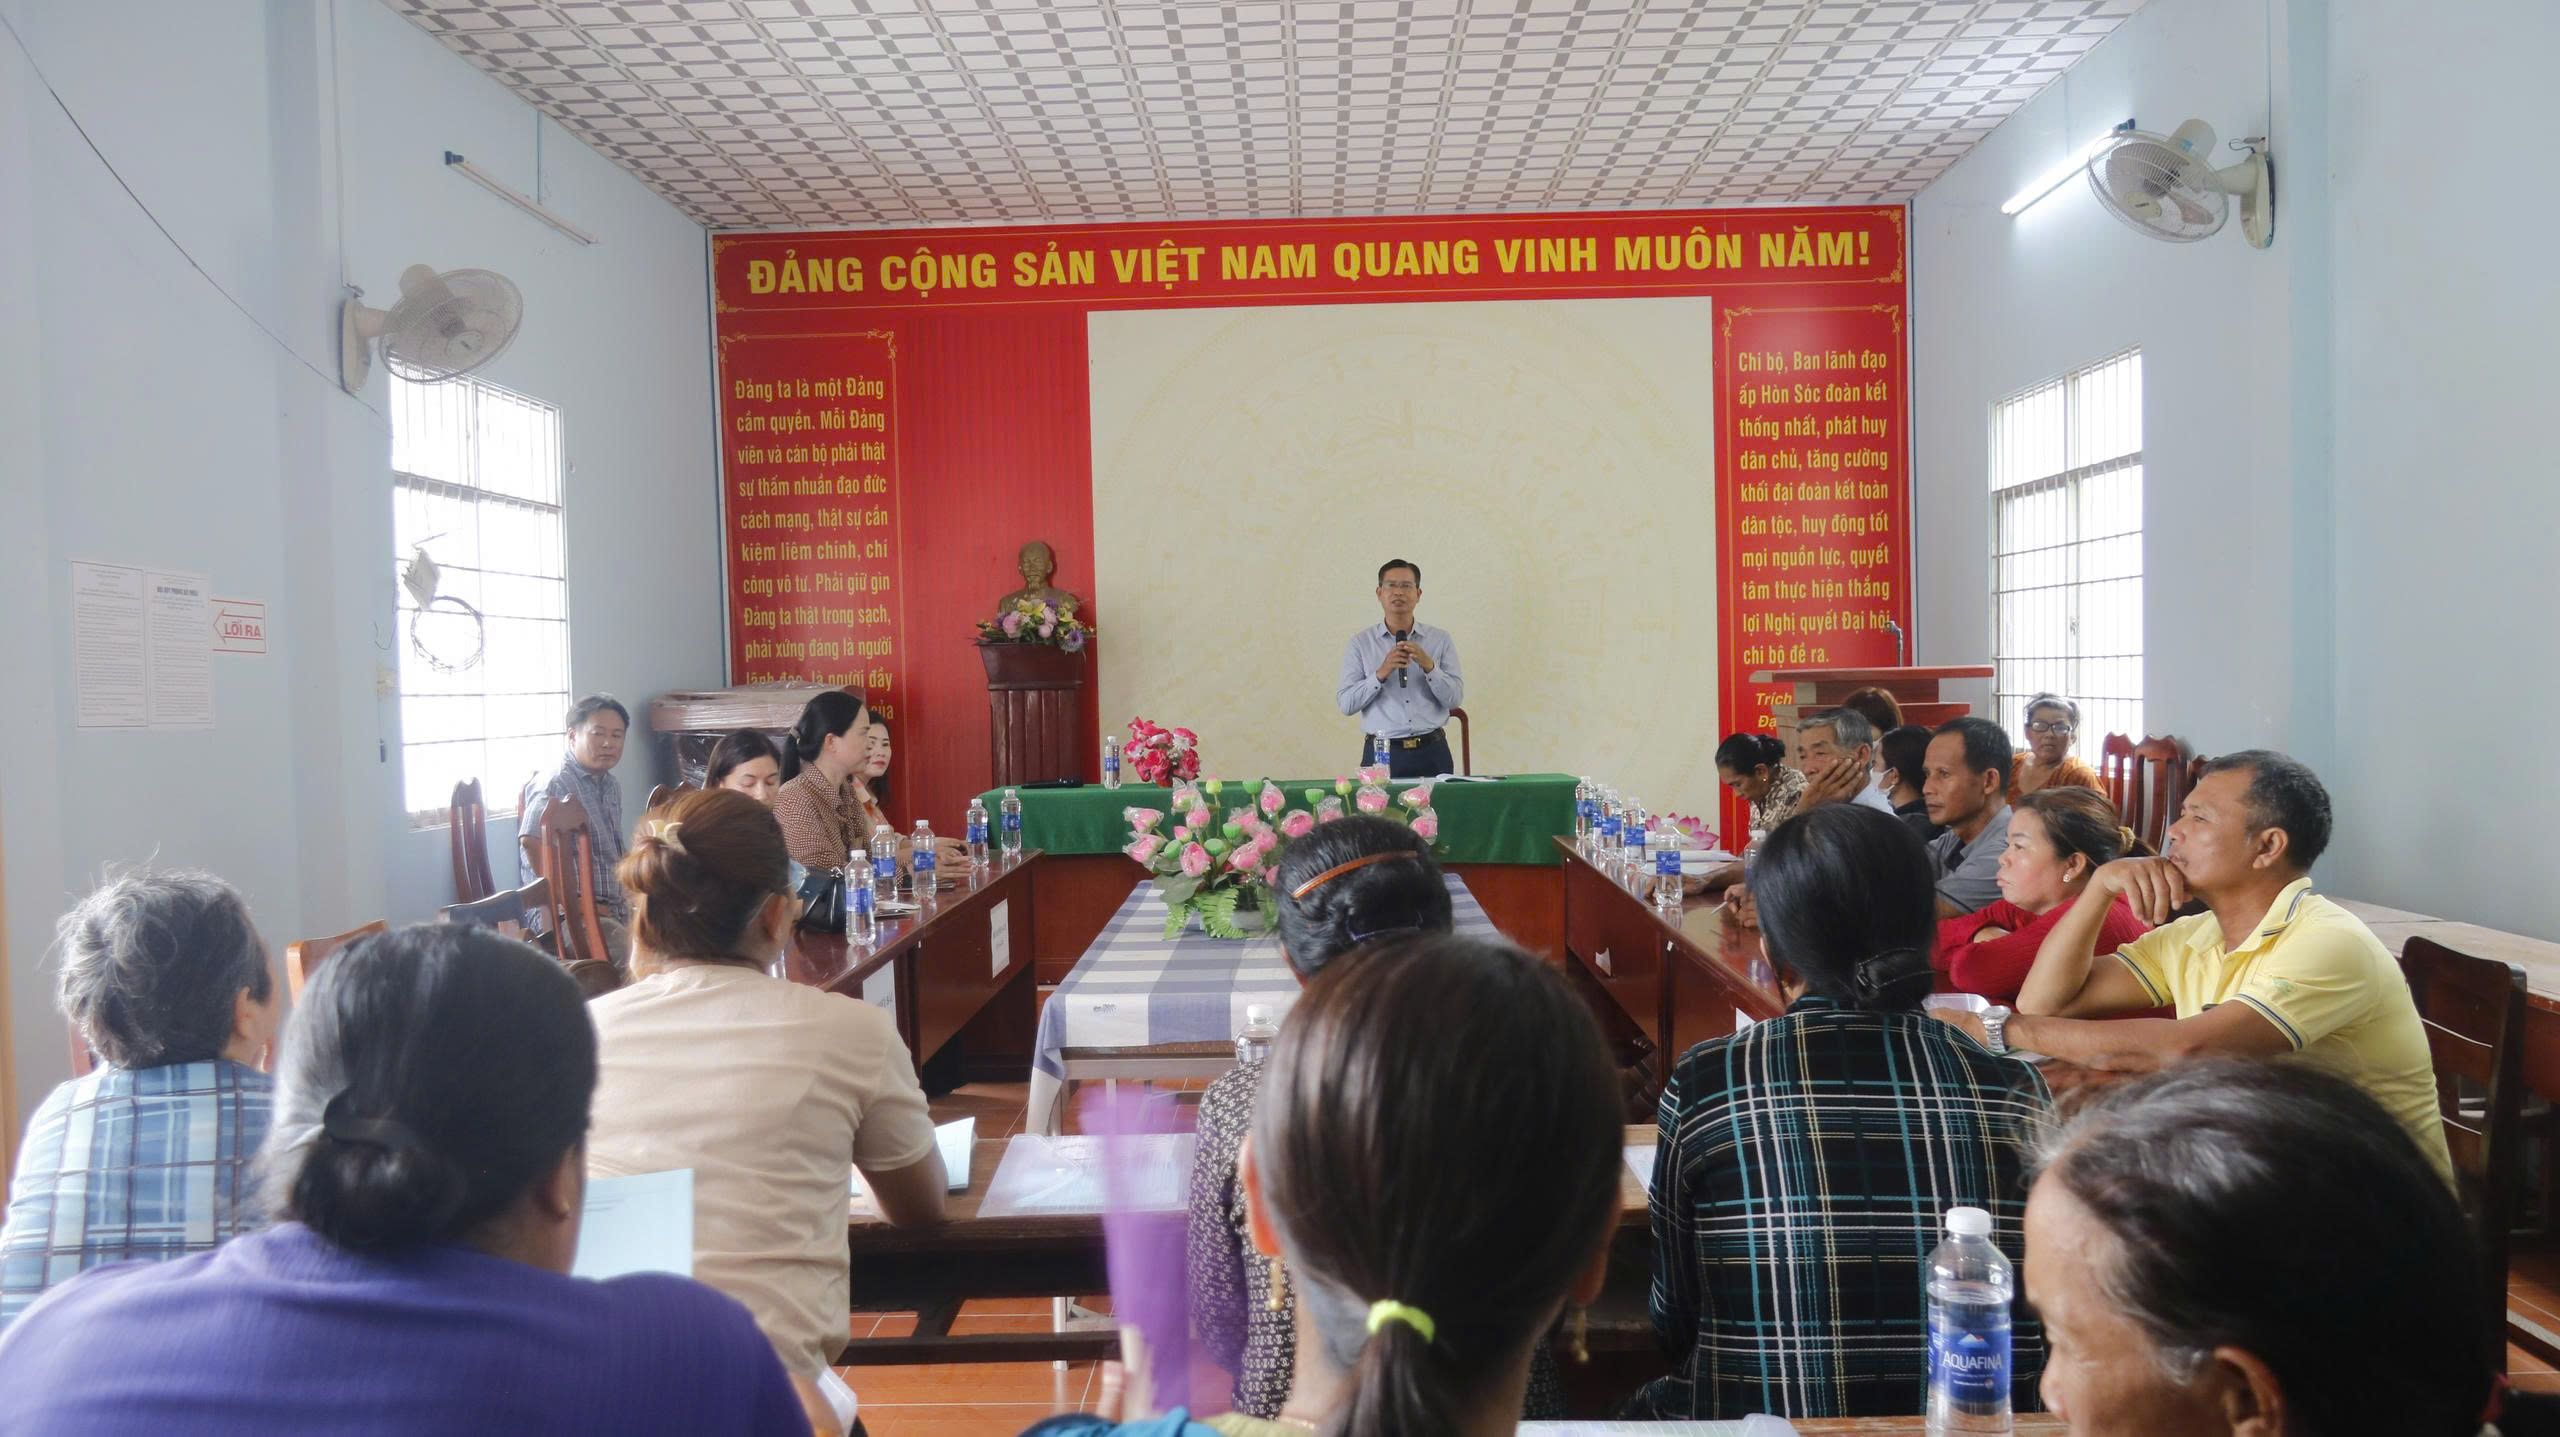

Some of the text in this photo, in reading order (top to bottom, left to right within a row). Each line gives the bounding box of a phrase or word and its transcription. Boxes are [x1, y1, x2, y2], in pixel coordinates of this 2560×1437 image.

[747, 225, 1870, 298] ĐẢNG CỘNG SẢN VIỆT NAM QUANG VINH MUÔN NĂM!
[1739, 350, 1887, 374] Chi bộ, Ban lãnh đạo
[1739, 380, 1887, 408] ấp Hòn Sóc đoàn kết
[1740, 414, 1887, 440] thống nhất, phát huy
[1741, 449, 1888, 471] dân chủ, tăng cường
[1741, 478, 1888, 505] khối đại đoàn kết toàn
[1742, 511, 1888, 538] dân tộc, huy động tốt
[1742, 543, 1888, 571] mọi nguồn lực, quyết
[1743, 576, 1889, 602] tâm thực hiện thắng
[246, 624, 261, 637] RA
[1744, 614, 1759, 635] lợi
[1765, 613, 1795, 635] Nghị
[1801, 610, 1837, 634] quyết
[1842, 611, 1864, 633] Đại
[1744, 643, 1829, 667] chi bộ đề ra.
[1756, 692, 1792, 705] Trích
[1759, 715, 1776, 730] Đạ
[1943, 1351, 2002, 1371] AQUAFINA
